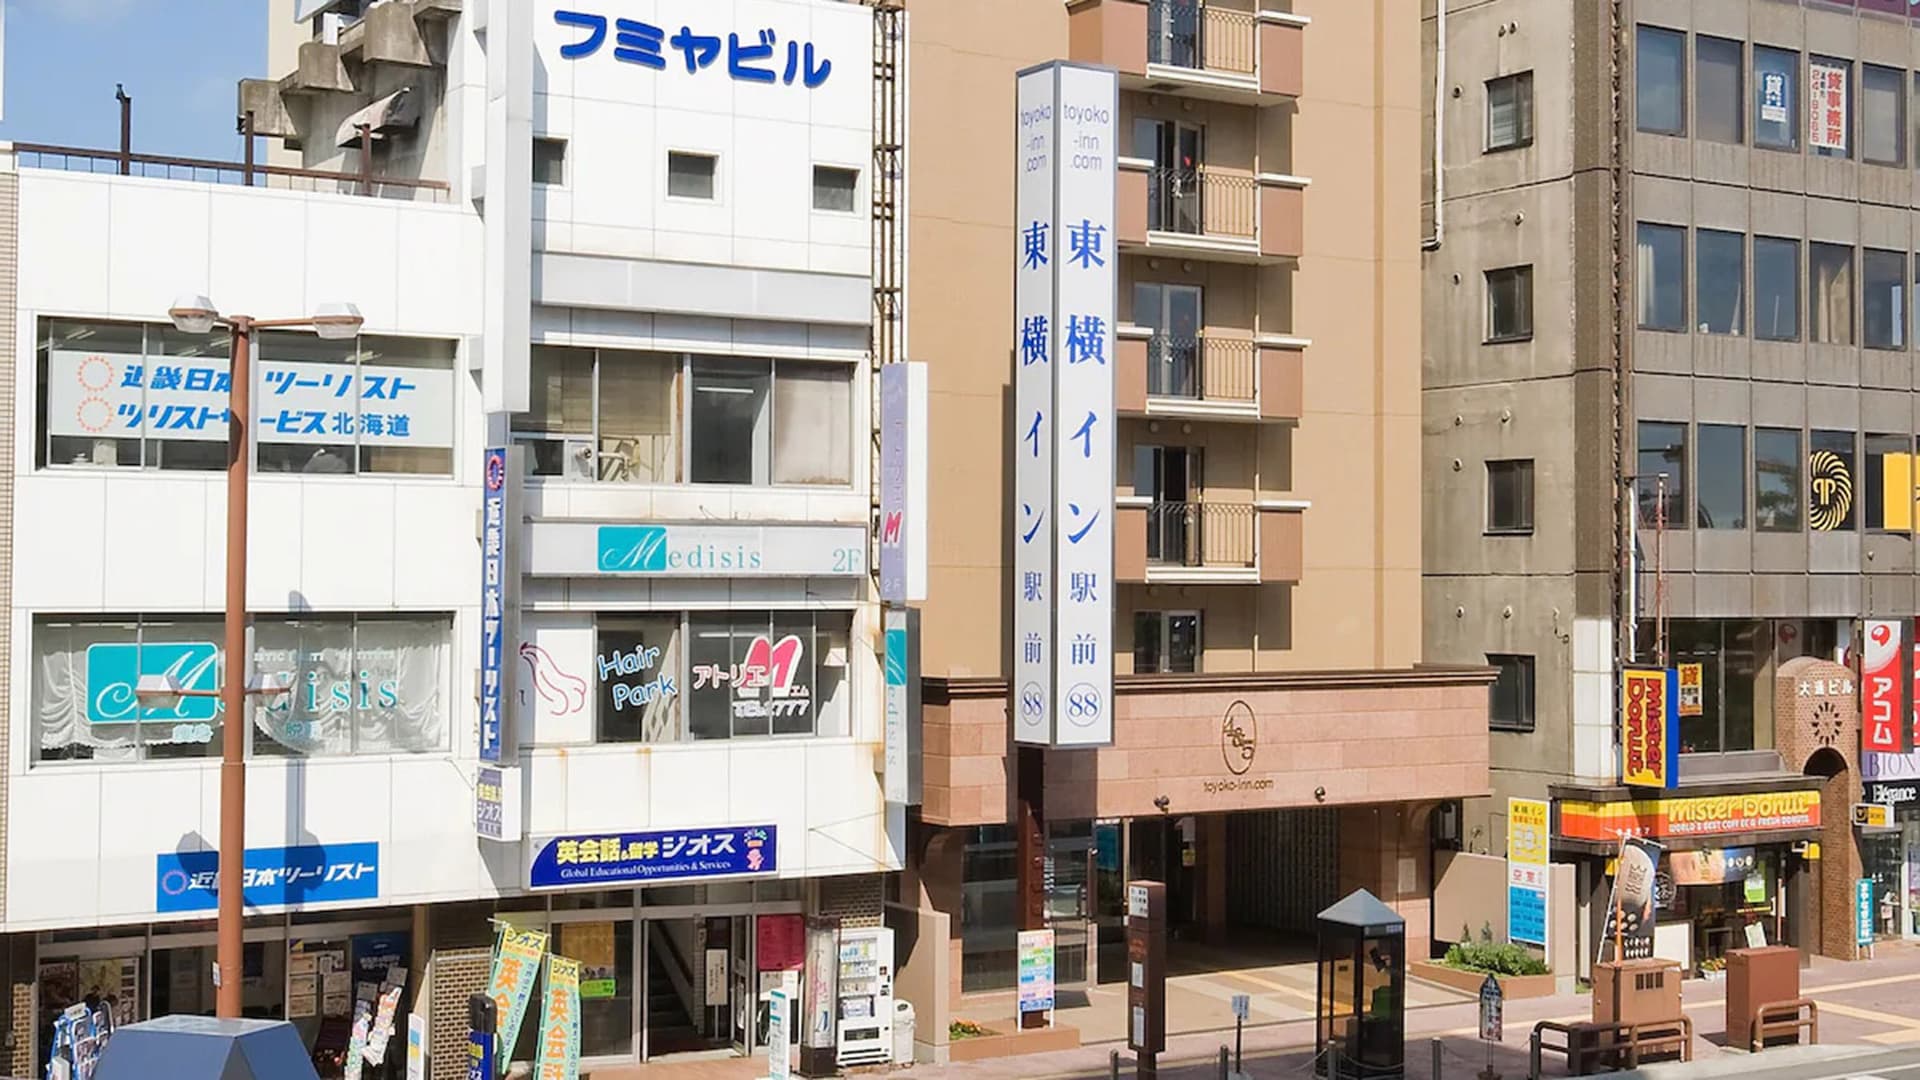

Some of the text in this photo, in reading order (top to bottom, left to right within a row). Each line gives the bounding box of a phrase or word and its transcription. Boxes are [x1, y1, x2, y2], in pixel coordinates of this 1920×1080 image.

[554, 10, 832, 88] フミヤビル
[1021, 104, 1051, 127] toyoko
[1064, 104, 1109, 125] toyoko
[1827, 71, 1842, 146] 貸事務所
[1027, 134, 1044, 151] -inn
[1073, 133, 1099, 150] -inn
[1024, 154, 1047, 173] .com
[1070, 153, 1102, 171] .com
[602, 530, 863, 572] Medisis 2F
[598, 645, 660, 681] Hair
[692, 662, 769, 689] アトリエ
[613, 673, 678, 711] Park
[1023, 691, 1042, 717] 88
[1068, 691, 1098, 718] 88
[1873, 676, 1893, 745] アコム
[1628, 677, 1645, 777] Donut
[1646, 679, 1662, 780] Mister
[1203, 779, 1274, 794] toyoko-inn.com
[1669, 795, 1809, 822] Mister Donut
[662, 834, 736, 858] ジオス
[188, 862, 375, 891] 近日本ツーリスト
[561, 868, 588, 879] Global
[590, 865, 637, 877] Educational
[637, 862, 691, 876] Opportunities
[699, 860, 731, 871] Services
